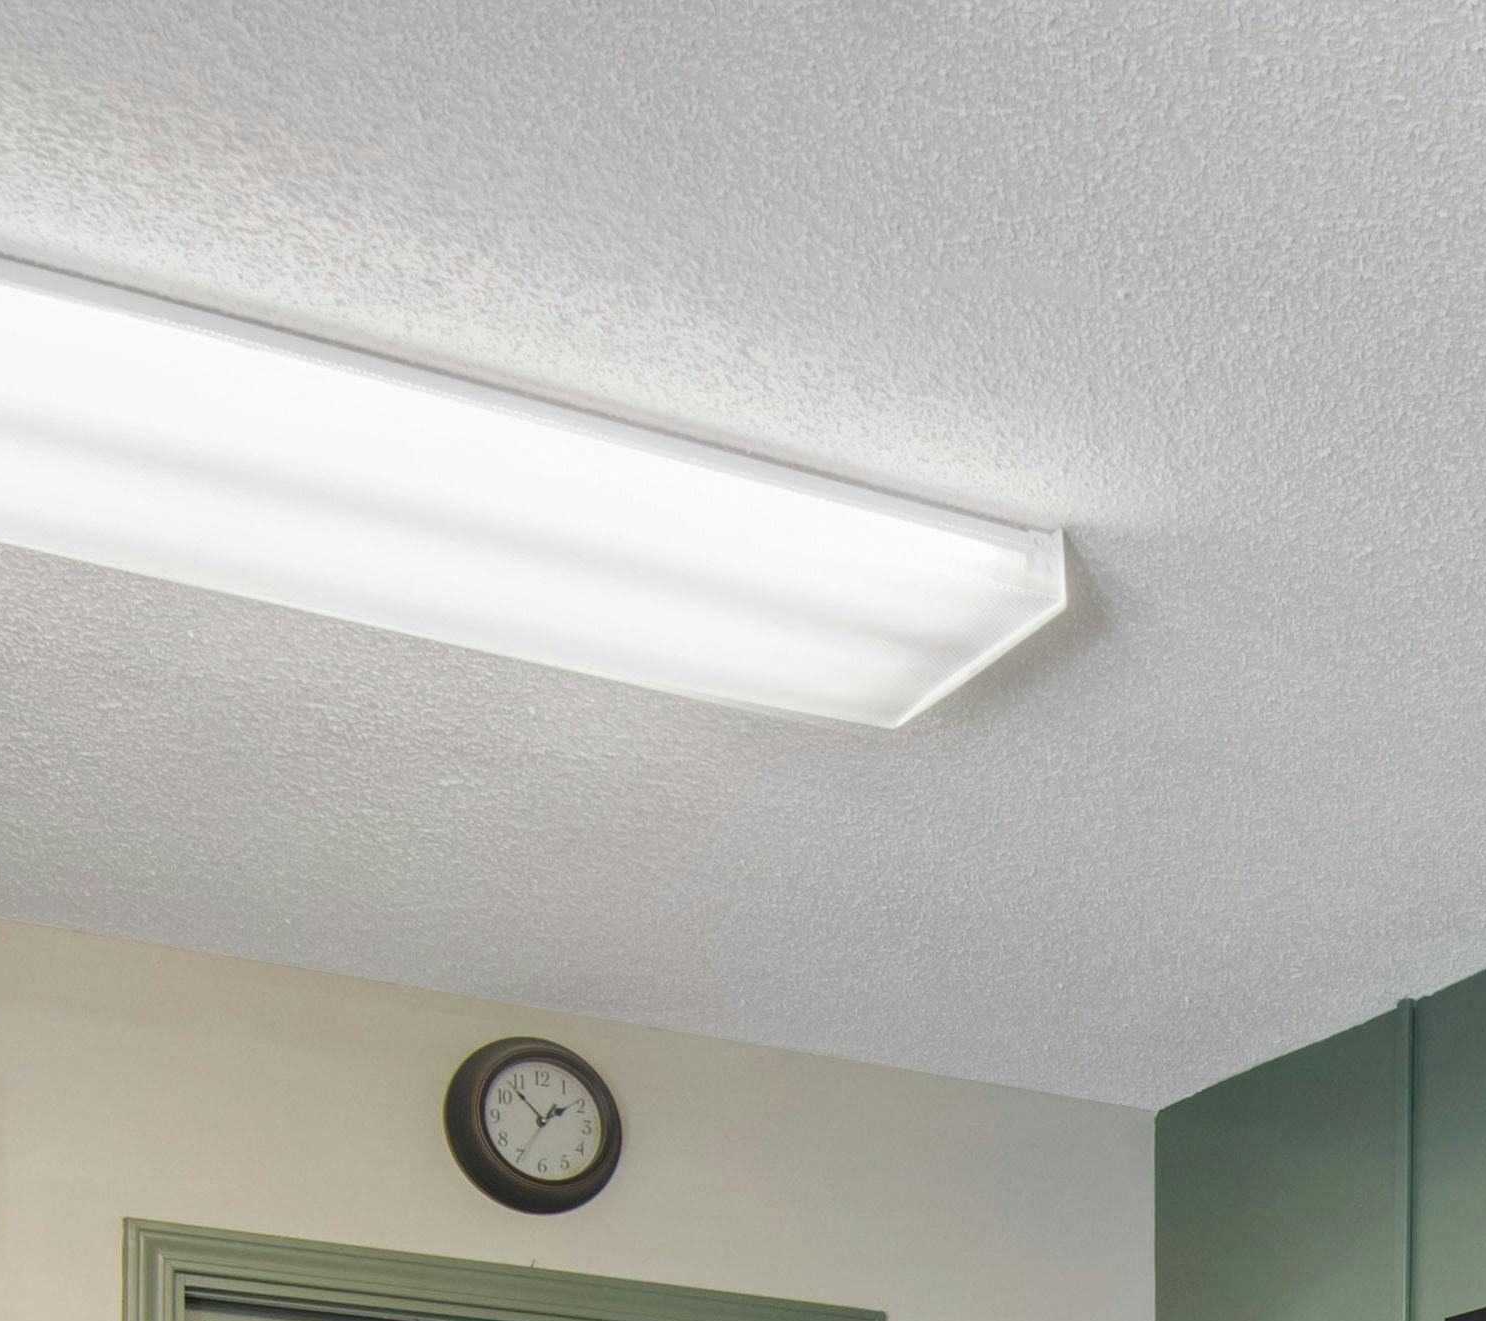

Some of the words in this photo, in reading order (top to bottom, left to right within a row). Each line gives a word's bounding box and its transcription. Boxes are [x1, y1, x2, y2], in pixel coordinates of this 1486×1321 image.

[513, 1073, 526, 1090] 11
[534, 1070, 551, 1088] 12
[561, 1079, 567, 1095] 1
[497, 1088, 513, 1105] 10
[576, 1099, 586, 1114] 2
[490, 1109, 501, 1124] 9
[581, 1120, 592, 1136] 3
[497, 1131, 509, 1147] 8
[515, 1148, 525, 1165] 7
[575, 1141, 585, 1157] 4
[537, 1158, 548, 1174] 6
[560, 1154, 570, 1170] 5
